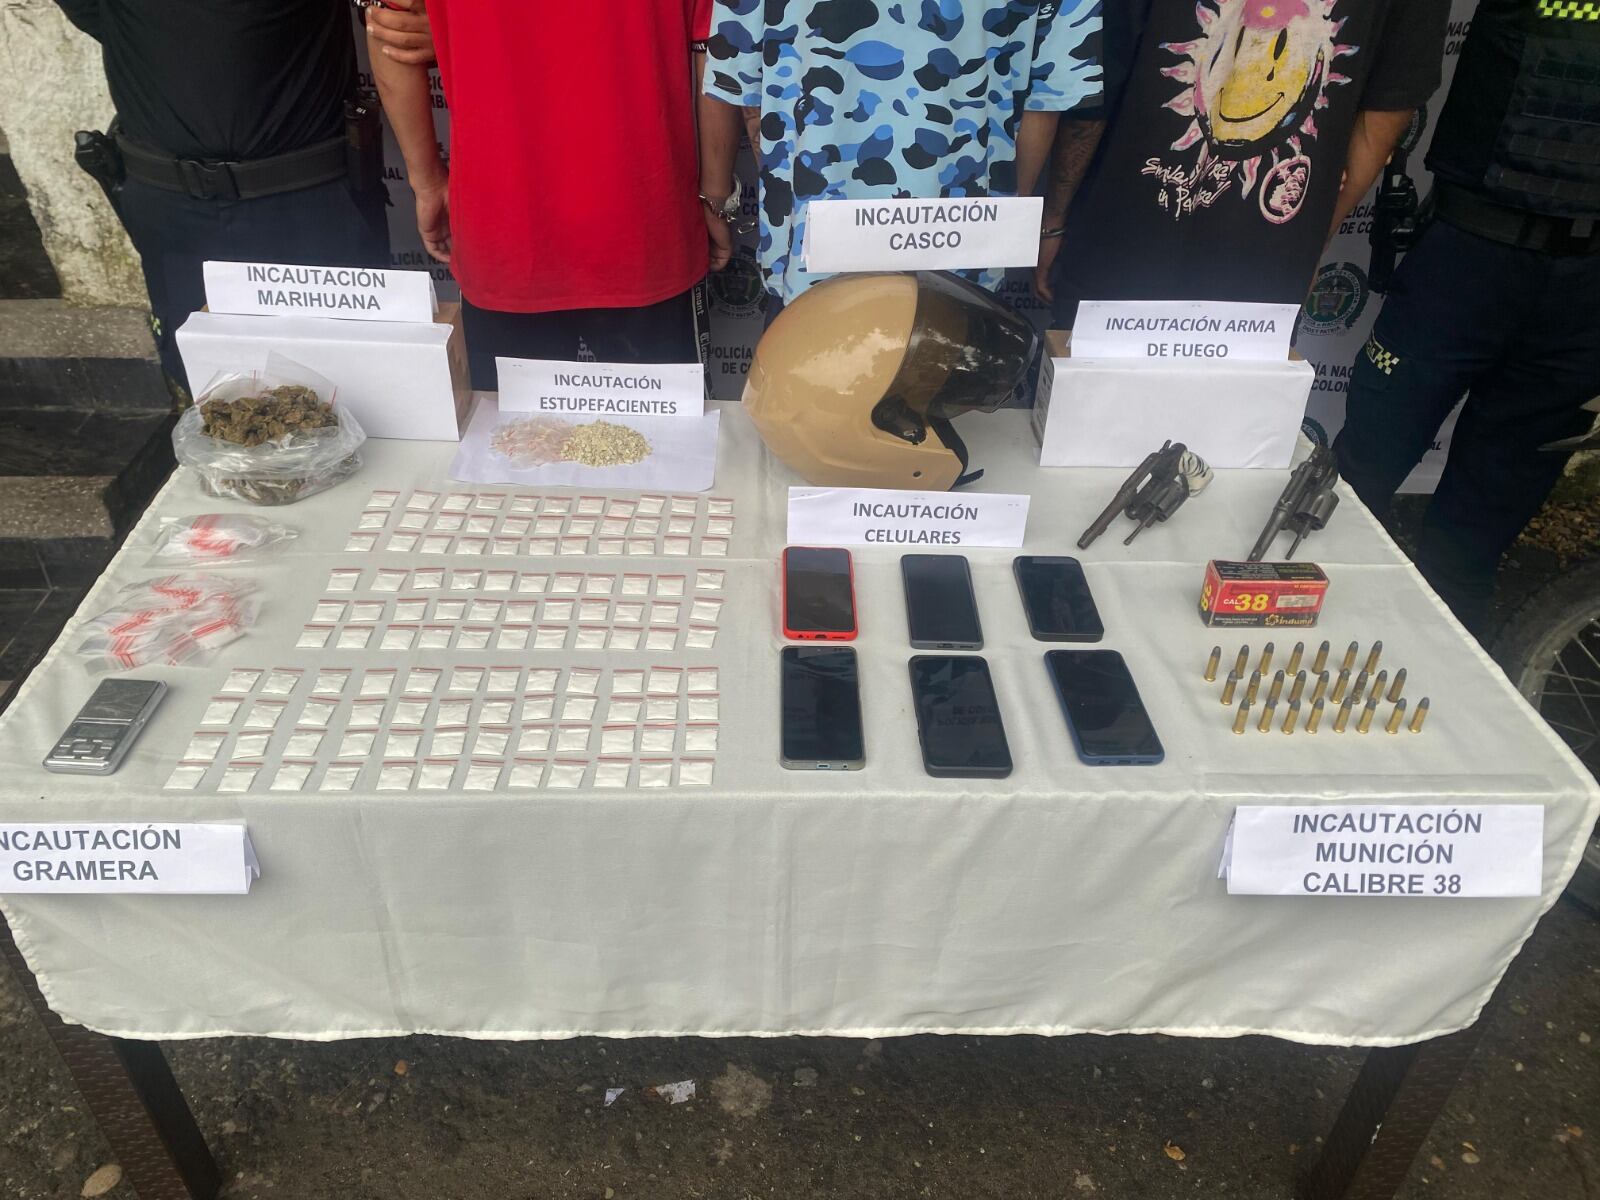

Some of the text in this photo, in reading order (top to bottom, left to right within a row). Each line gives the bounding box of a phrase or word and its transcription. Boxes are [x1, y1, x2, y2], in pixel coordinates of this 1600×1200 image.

[855, 202, 997, 227] INCAUTACIÓN
[889, 231, 962, 250] CASCO
[247, 265, 386, 290] INCAUTACIÓN
[258, 290, 381, 311] MARIHUANA
[1106, 315, 1276, 333] INCAUTACIÓN ARMA
[1147, 343, 1229, 358] DE FUEGO
[721, 362, 737, 375] DE
[554, 373, 662, 390] INCAUTACIÓN
[540, 397, 677, 415] ESTUPEFACIENTES
[853, 502, 979, 521] INCAUTACIÓN
[864, 528, 961, 545] CELULARES
[1234, 593, 1269, 612] 38
[1293, 808, 1482, 834] INCAUTACIÓN
[0, 825, 181, 851] NCAUTACIÓN
[1315, 839, 1454, 865] MUNICIÓN
[13, 860, 159, 882] GRAMERA
[1303, 871, 1462, 895] CALIBRE 38
